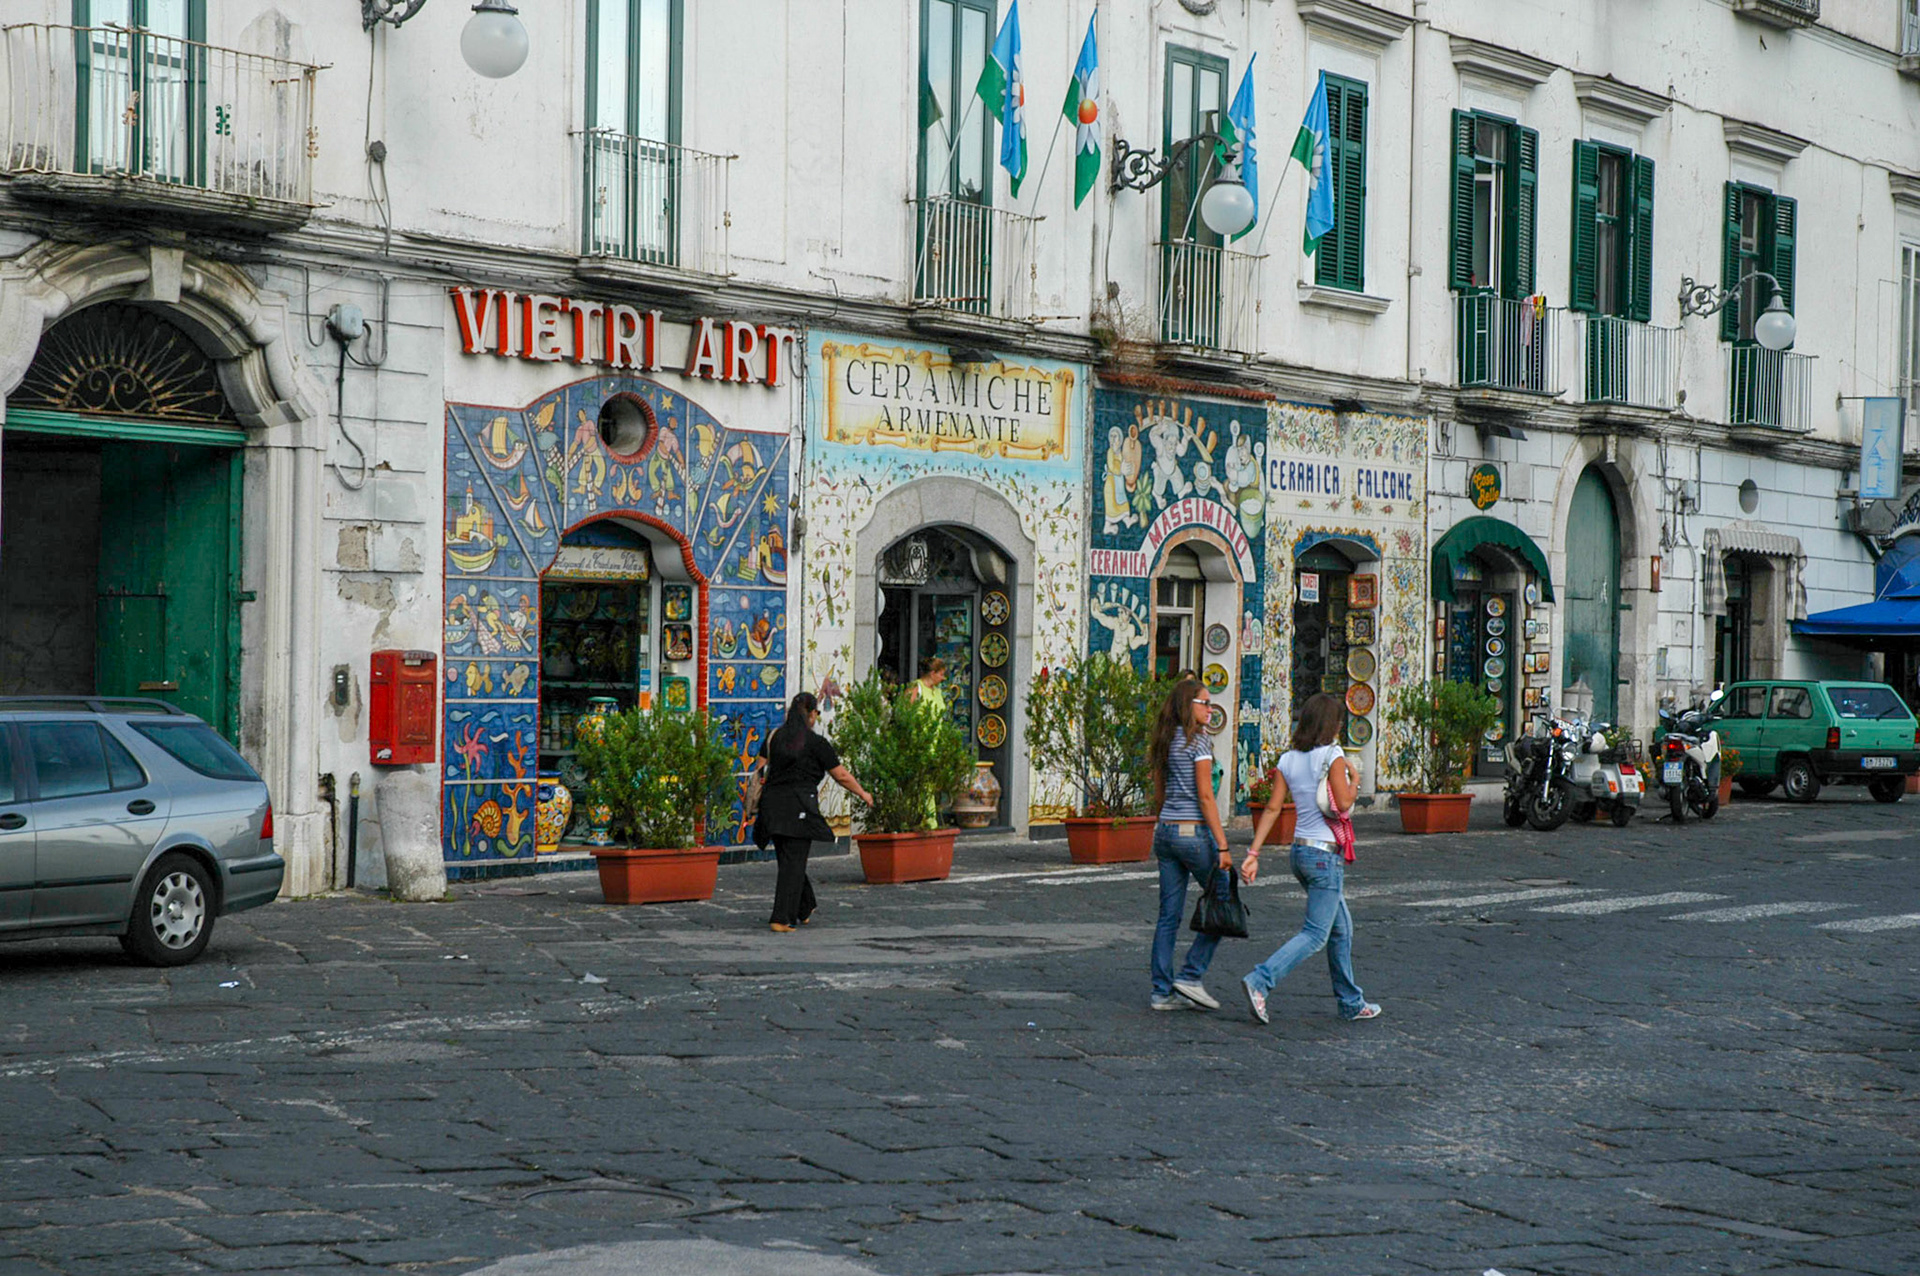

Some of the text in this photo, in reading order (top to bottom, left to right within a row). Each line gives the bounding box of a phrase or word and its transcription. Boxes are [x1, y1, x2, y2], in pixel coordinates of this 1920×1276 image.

[450, 286, 795, 388] VIETRI ART
[846, 359, 1052, 416] CERAMICHE
[876, 404, 1021, 443] ARMENANTE
[1270, 459, 1412, 501] CERAMICA FALCONE
[1477, 487, 1500, 509] Belle
[1149, 498, 1249, 559] MASSIMINO
[1090, 550, 1148, 576] CERAMICA
